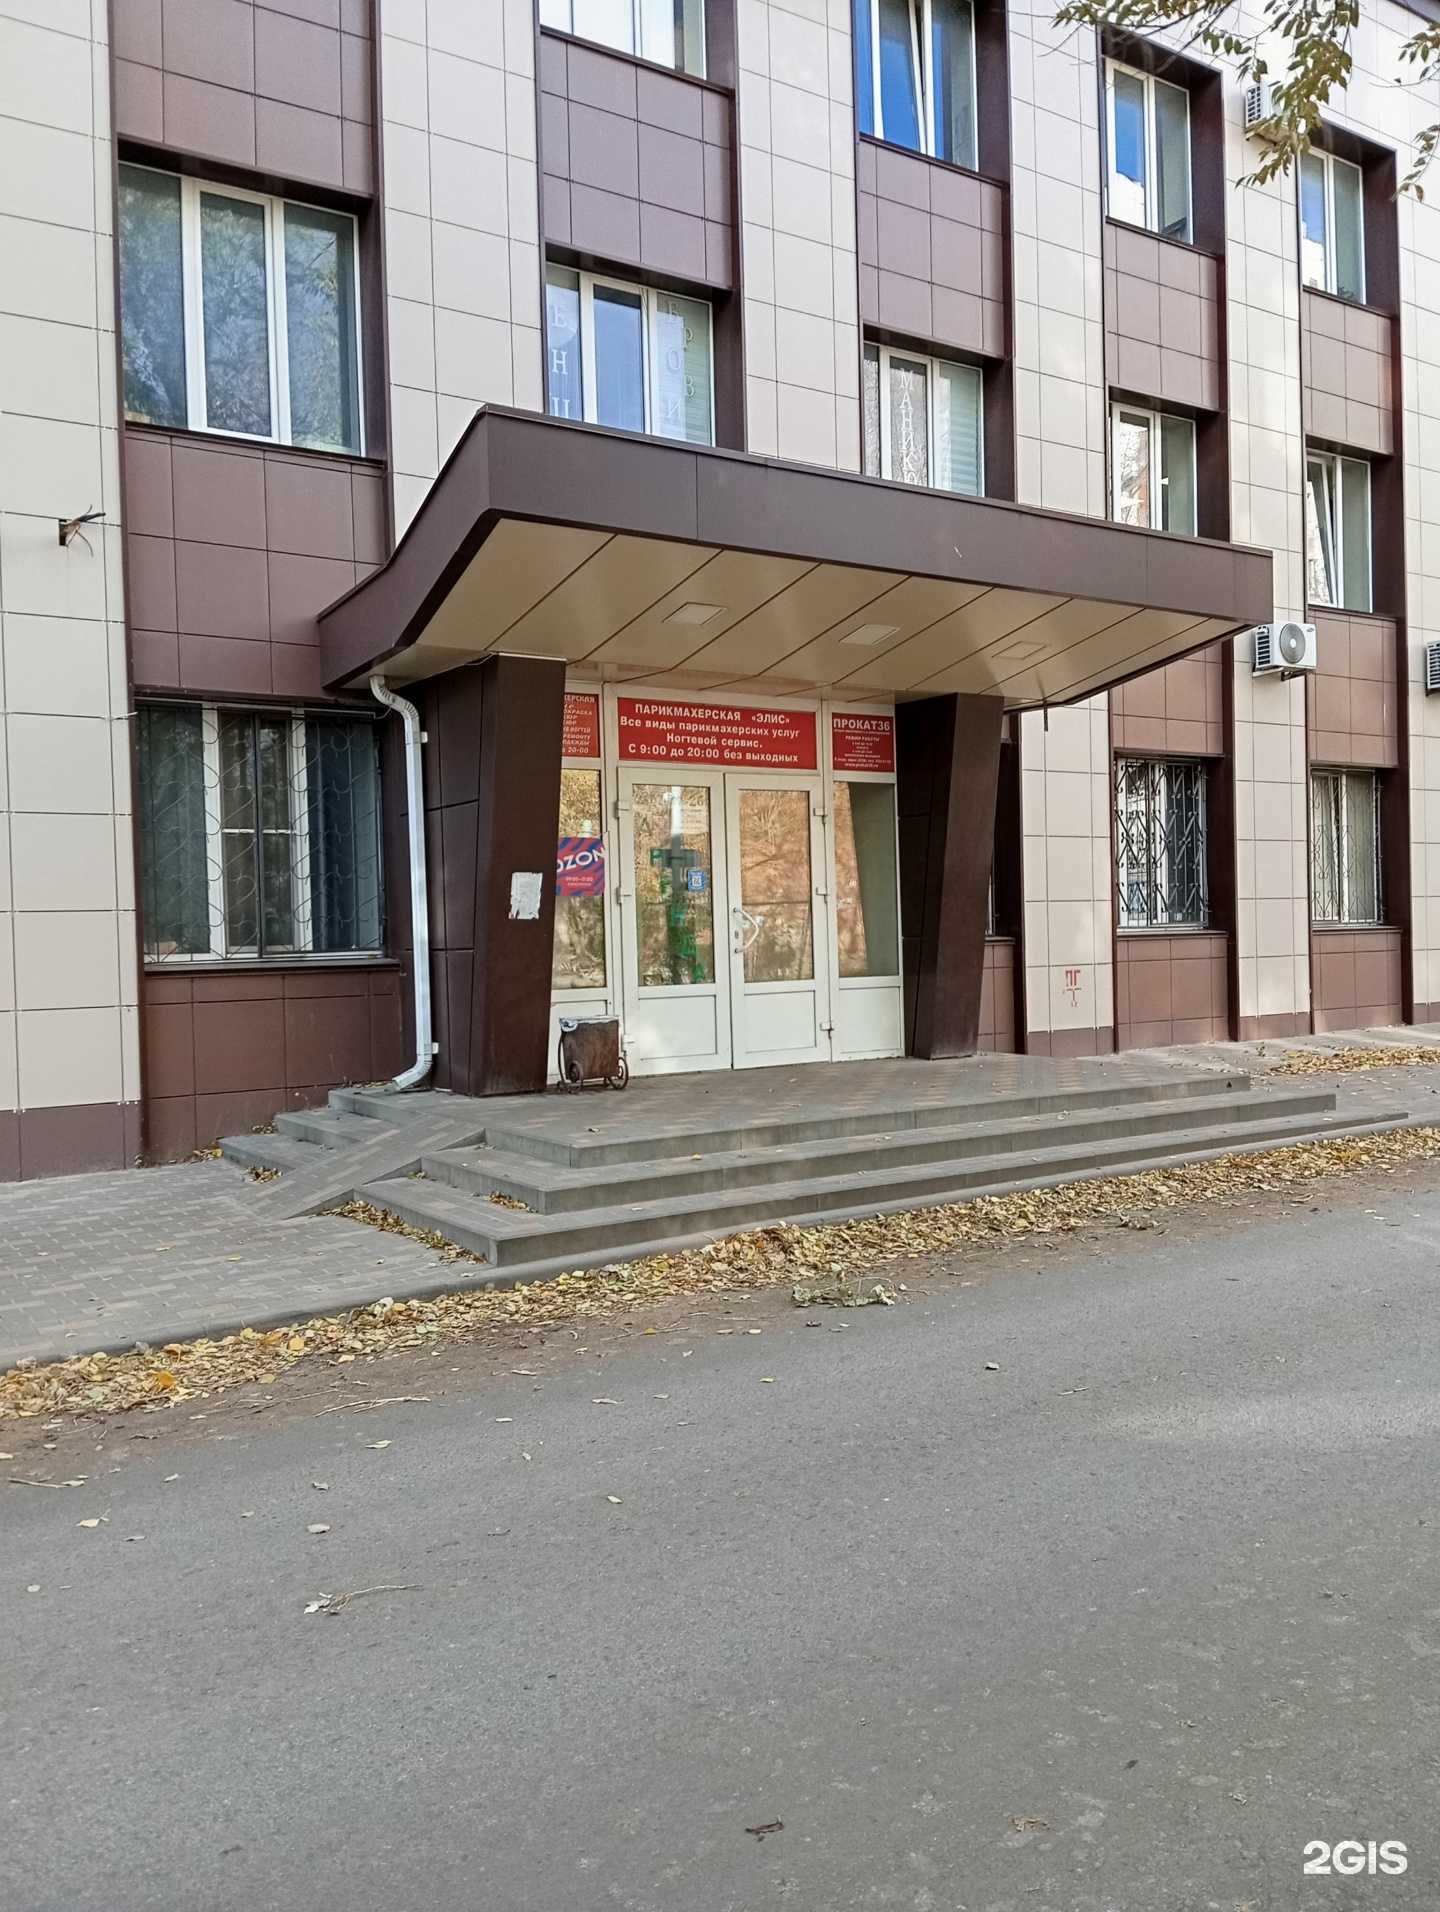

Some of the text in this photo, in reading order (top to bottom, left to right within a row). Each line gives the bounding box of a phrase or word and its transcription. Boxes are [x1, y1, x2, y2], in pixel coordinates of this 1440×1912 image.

[635, 703, 790, 724] ПАРИКМАХЕРСКАЯ «ЭЛИС»
[620, 715, 800, 739] Все виды парикмахерских услуг
[833, 718, 890, 731] ПРОКАТ36
[666, 732, 763, 748] Ногтевой сервис.
[628, 743, 799, 763] С 9:00 до 20:00 без выходных
